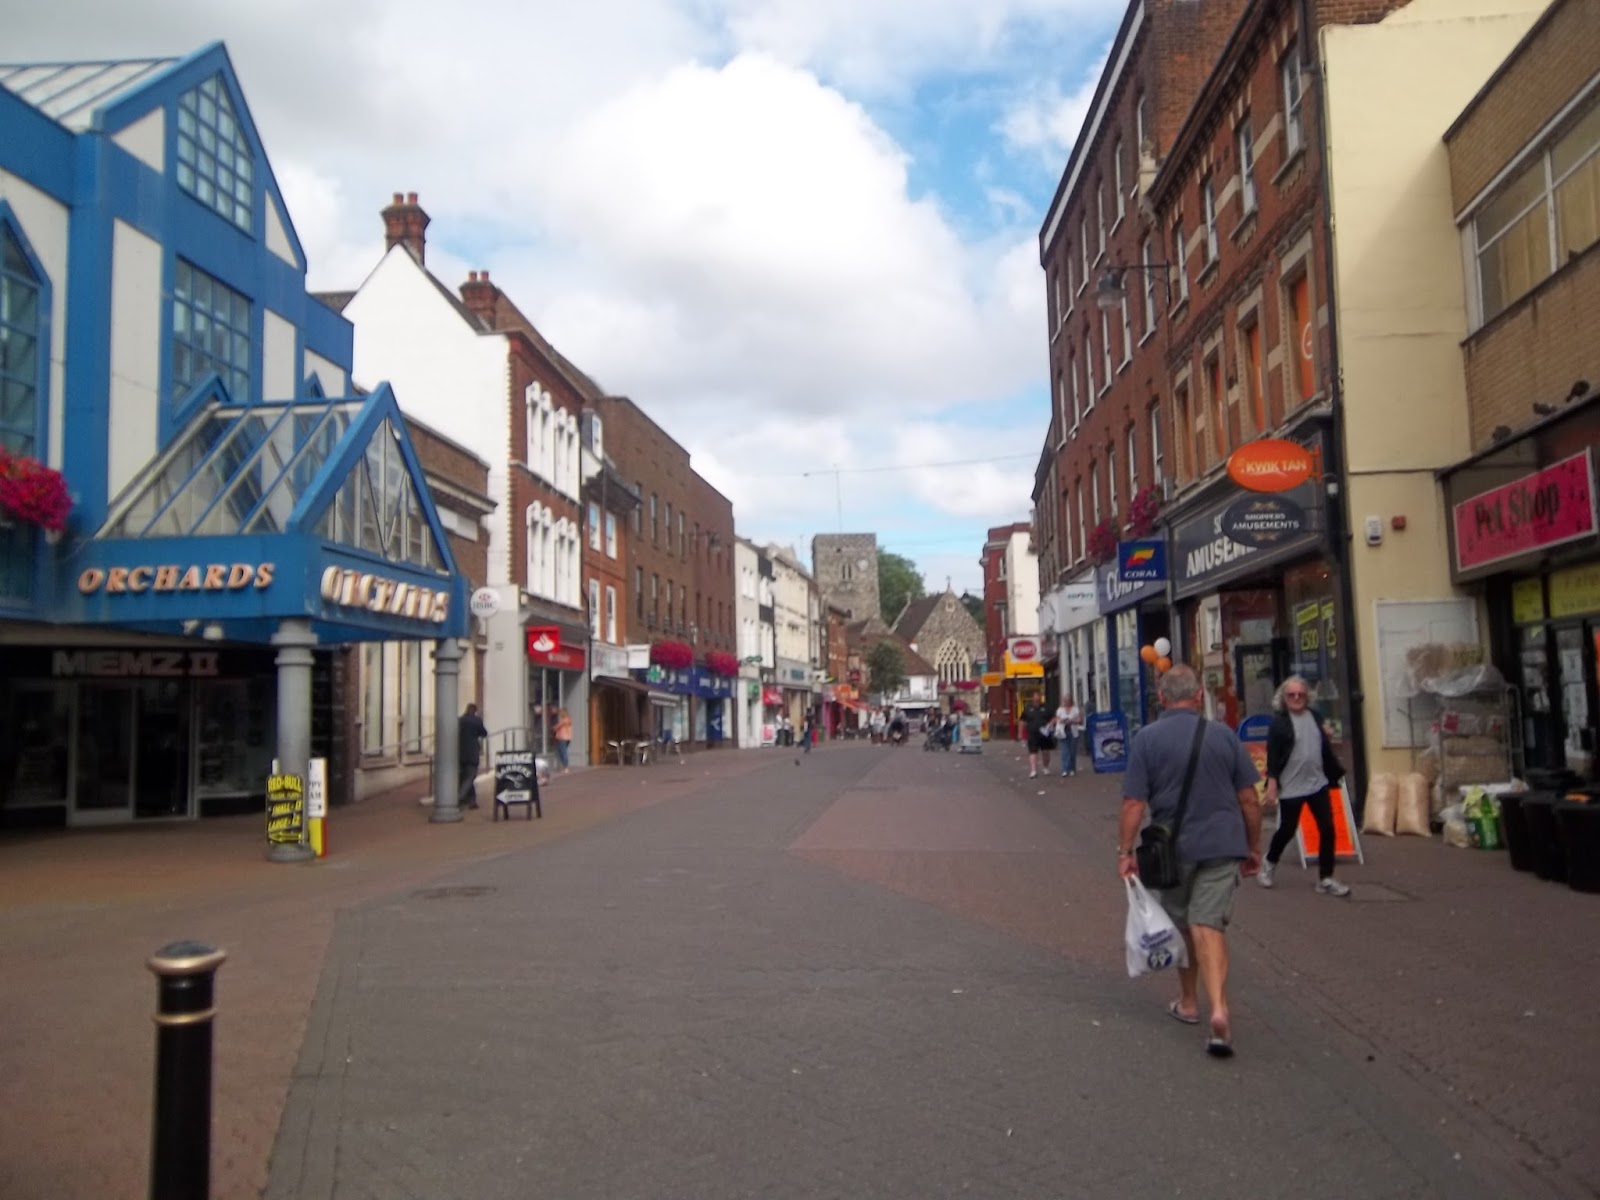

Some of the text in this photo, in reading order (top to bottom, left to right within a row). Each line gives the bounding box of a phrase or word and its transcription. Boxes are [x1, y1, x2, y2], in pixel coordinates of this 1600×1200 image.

[1245, 461, 1279, 473] KWIK
[1473, 482, 1560, 538] Pet Shop
[1232, 520, 1300, 531] AMUSEMENTS
[77, 561, 275, 595] ORCHARDS
[1124, 569, 1158, 579] CORAL
[472, 600, 497, 610] HSBC
[52, 650, 184, 677] MEMZ
[495, 752, 532, 764] MEMZ
